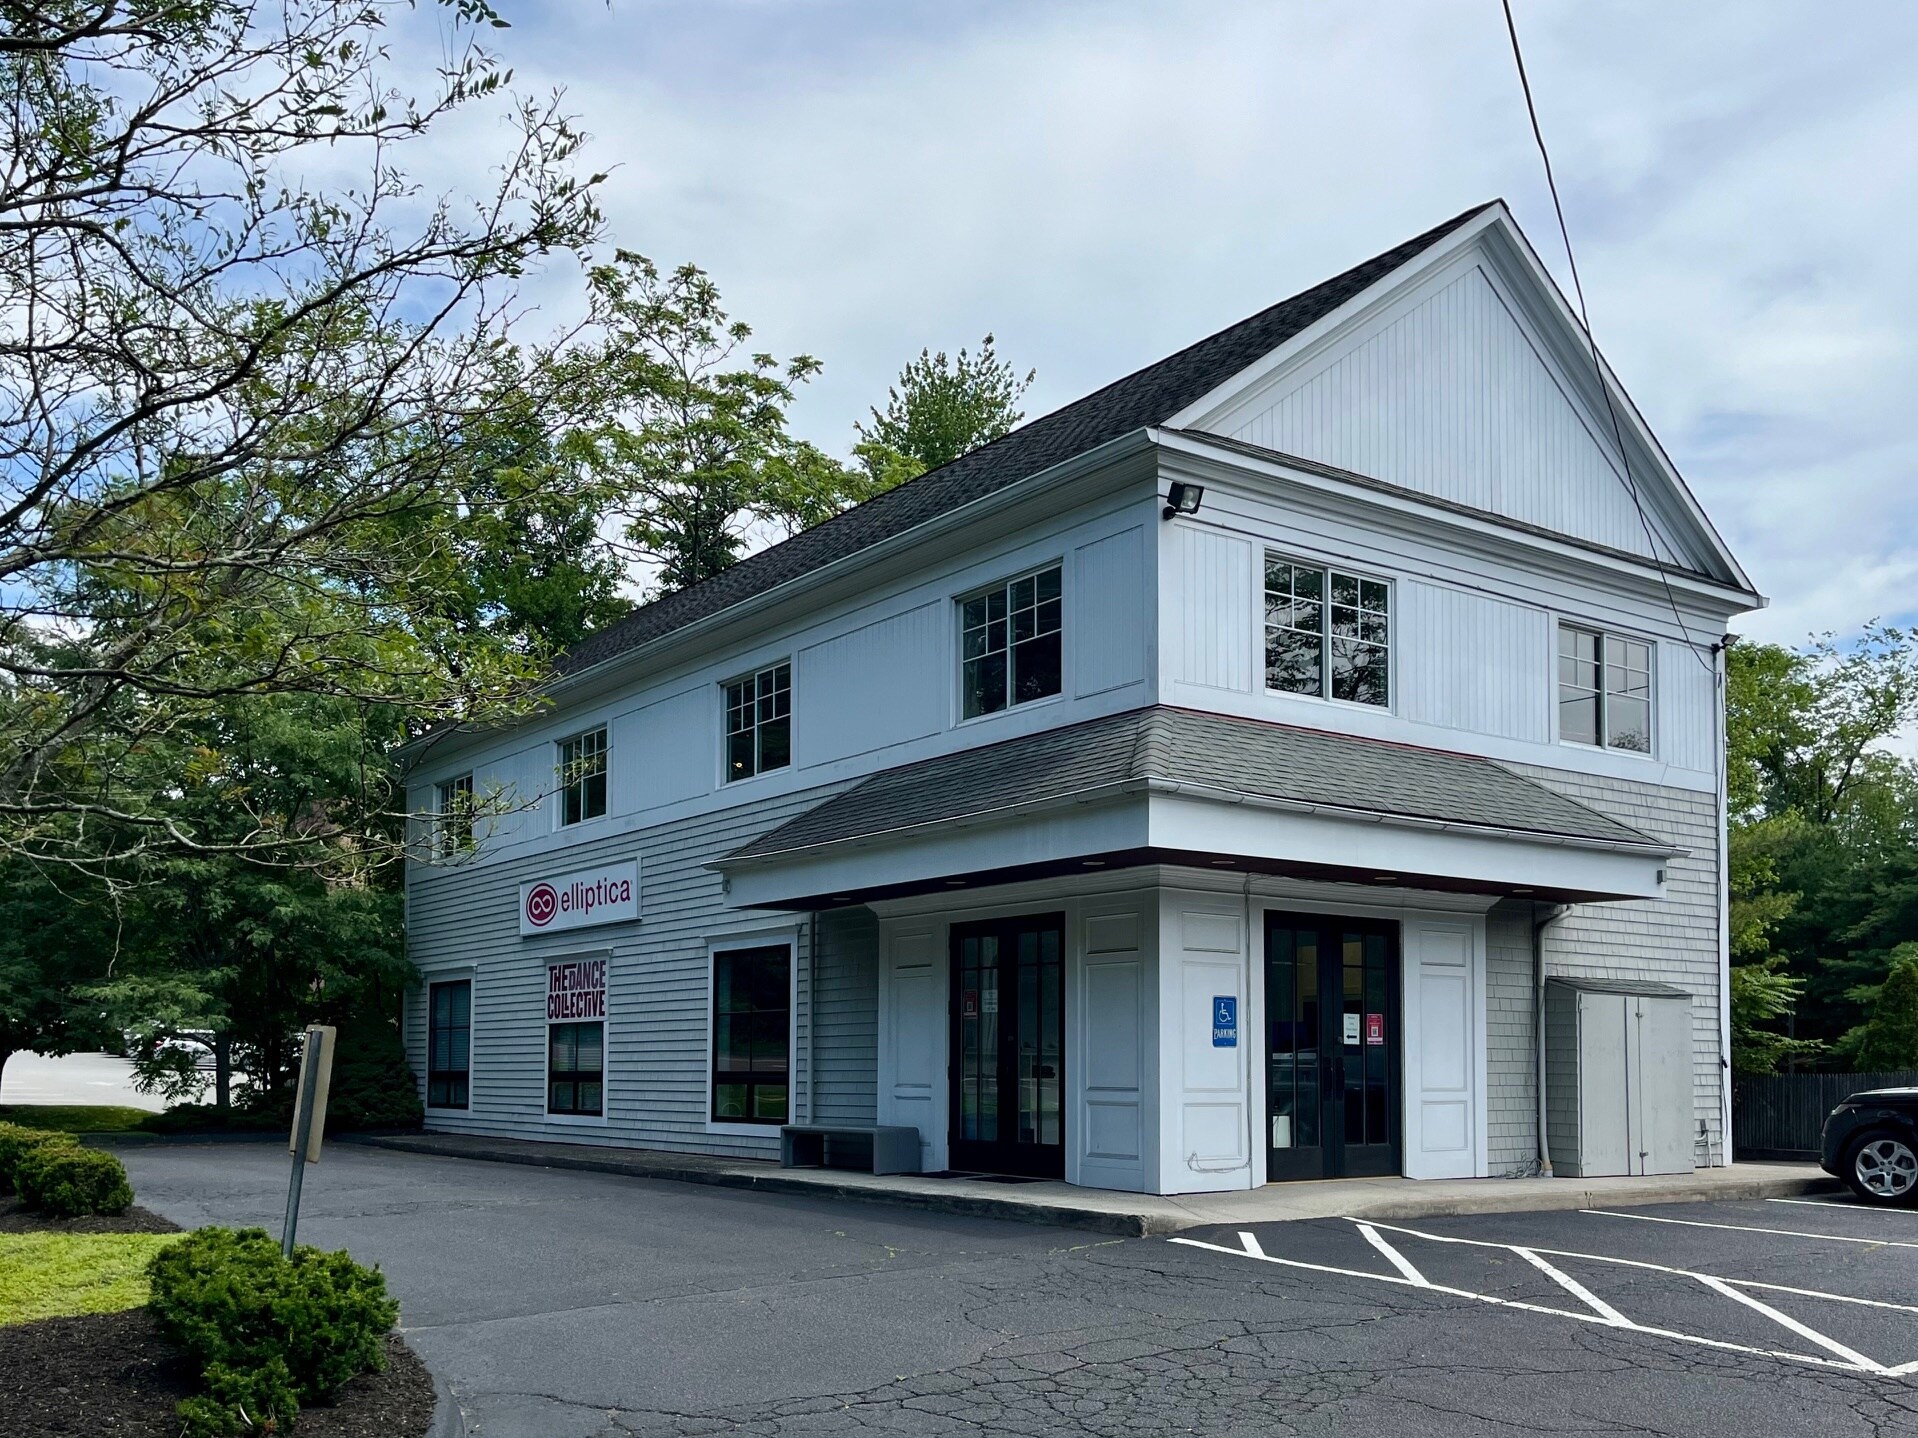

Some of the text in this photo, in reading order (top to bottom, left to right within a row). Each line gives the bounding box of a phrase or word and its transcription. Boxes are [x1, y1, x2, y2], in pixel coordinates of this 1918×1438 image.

[561, 877, 631, 915] elliptica
[548, 960, 607, 992] THE DANCE
[547, 990, 606, 1019] COLLECTIVE
[1213, 1028, 1236, 1040] PARKING
